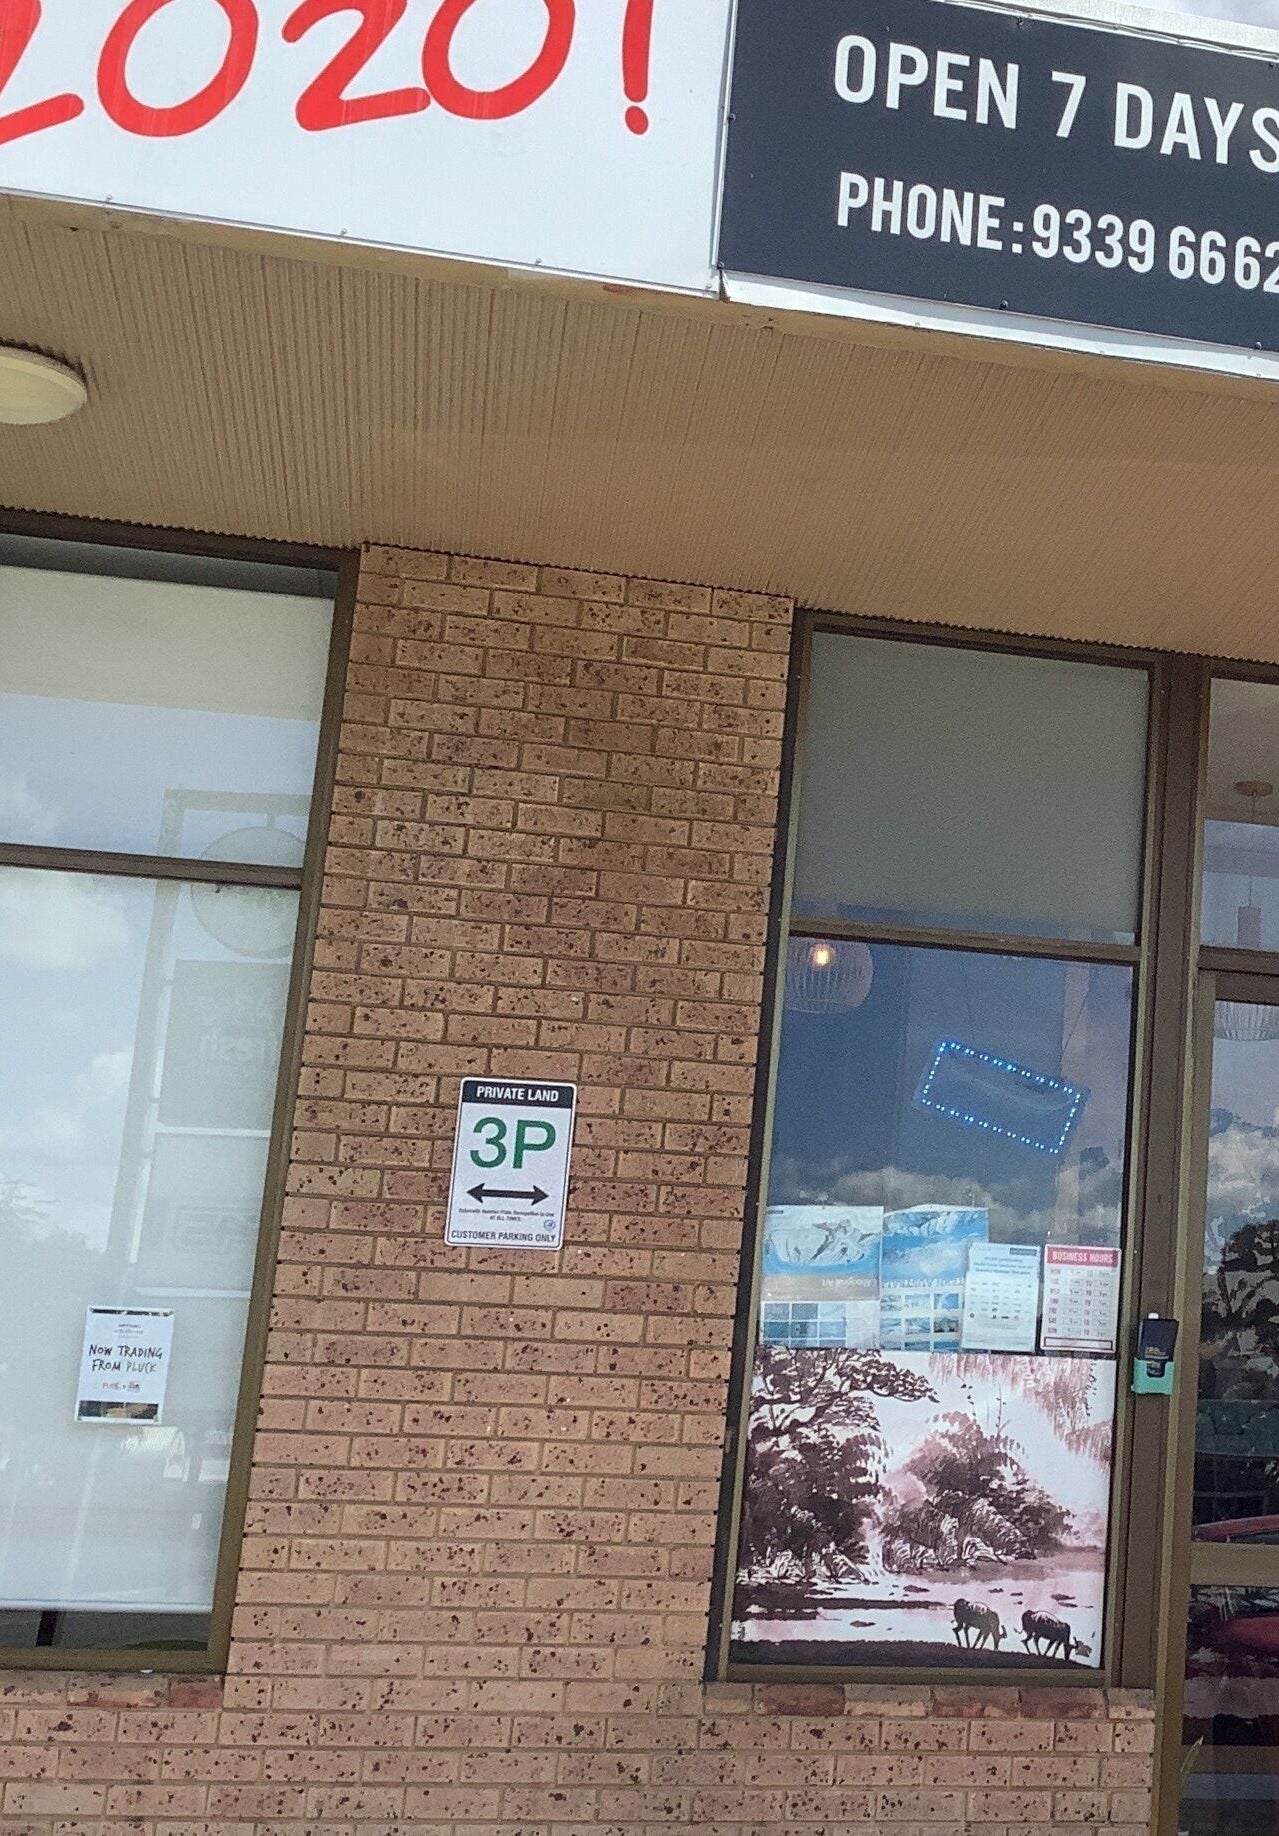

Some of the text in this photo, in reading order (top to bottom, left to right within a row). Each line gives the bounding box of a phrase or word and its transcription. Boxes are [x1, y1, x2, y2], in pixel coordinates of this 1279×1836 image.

[834, 34, 1019, 129] OPEN
[1051, 70, 1087, 138] 7
[476, 1085, 559, 1102] PRIVATE LAND
[470, 1116, 556, 1169] 3P
[451, 1230, 556, 1243] CUSTOMER PARKING ONLY
[1052, 1250, 1113, 1264] BUSINESS HOURS
[88, 1344, 163, 1360] NOW TRADING
[92, 1358, 157, 1374] FROM PLUCK
